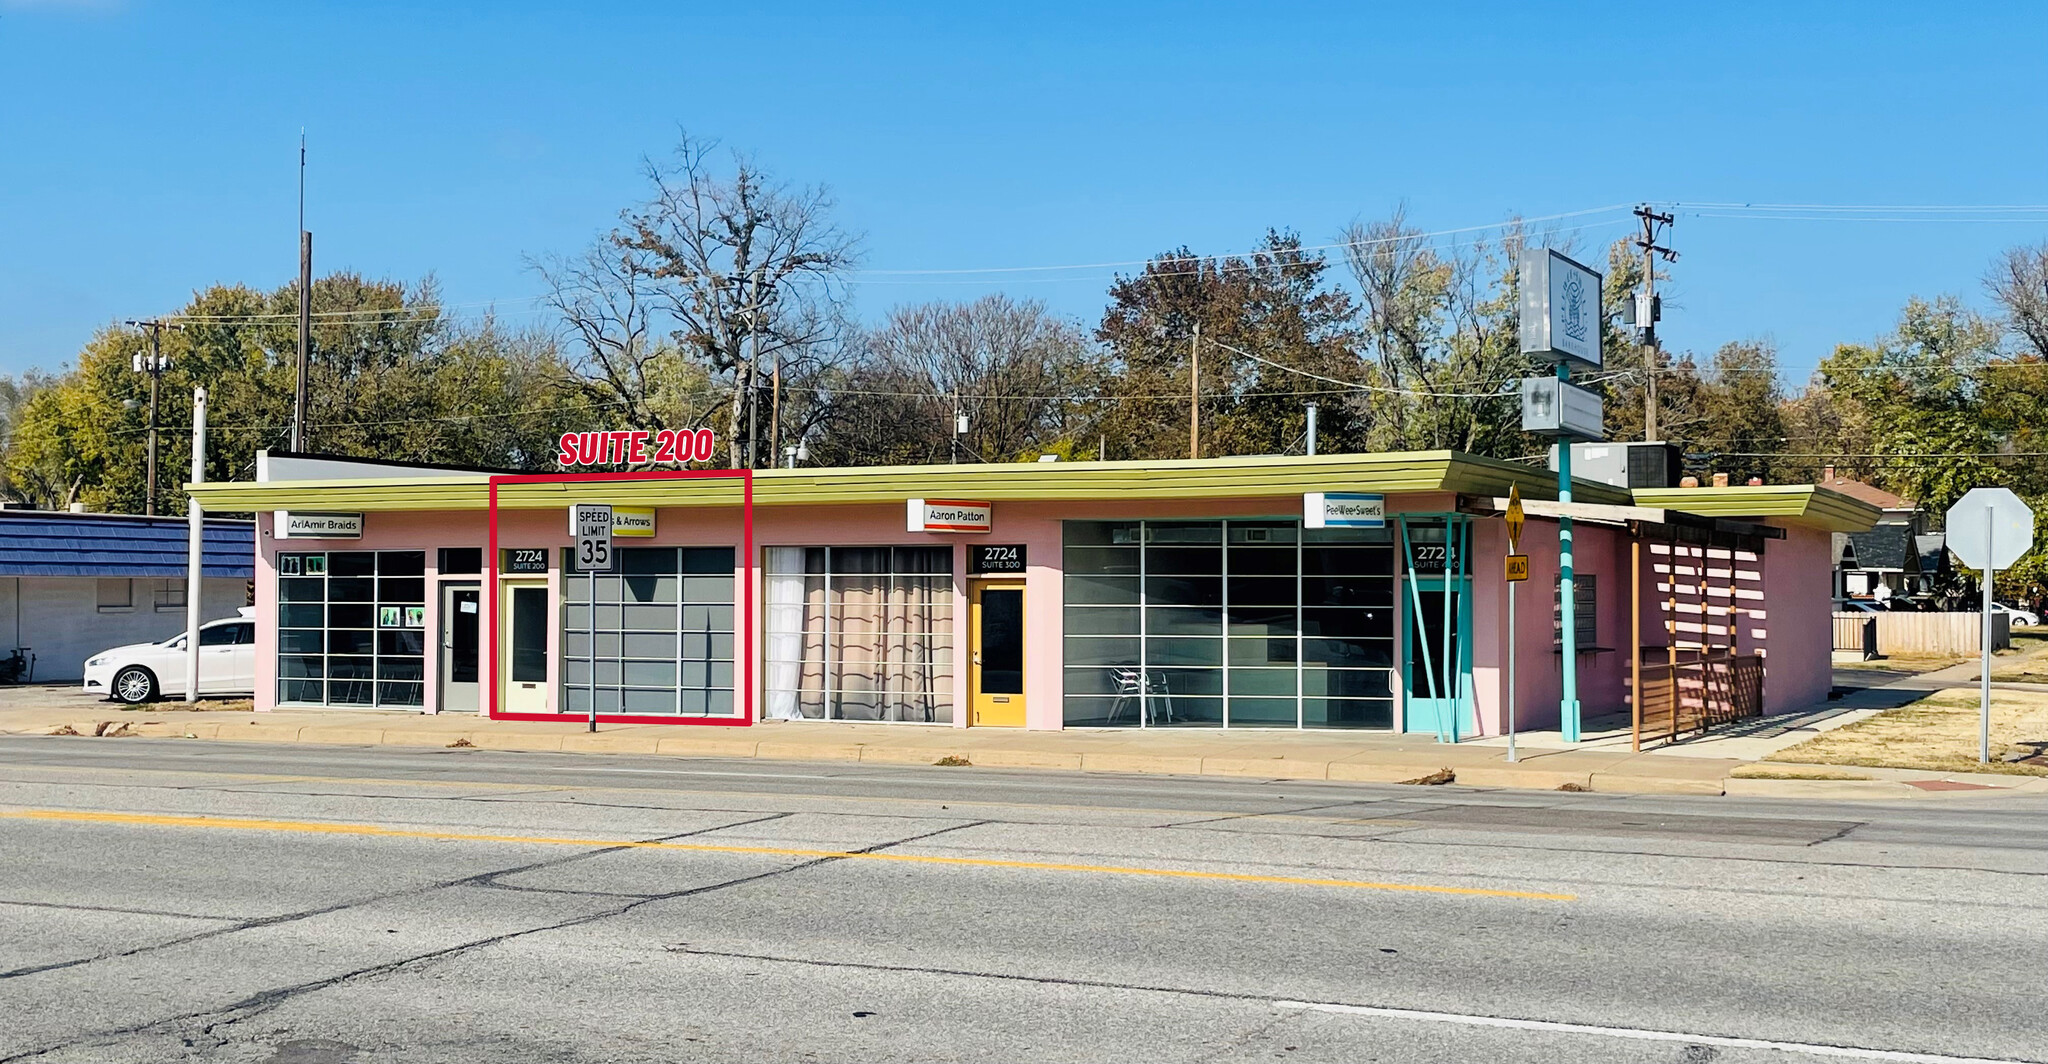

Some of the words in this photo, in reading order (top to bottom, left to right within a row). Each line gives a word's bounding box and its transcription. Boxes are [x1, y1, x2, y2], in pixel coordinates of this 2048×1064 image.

[579, 511, 609, 523] SPEED
[930, 510, 956, 520] Aaron
[957, 511, 985, 521] Patton
[327, 520, 357, 530] Braids
[616, 516, 623, 526] &
[623, 516, 651, 527] Arrows
[582, 525, 606, 537] LIMIT
[515, 550, 543, 562] 2724
[581, 539, 608, 564] 35
[984, 547, 1018, 560] 2724
[513, 562, 532, 570] SUITE
[532, 562, 546, 570] 200
[982, 561, 1003, 569] SUITE
[1005, 561, 1021, 569] 300
[1414, 560, 1440, 569] SUITE
